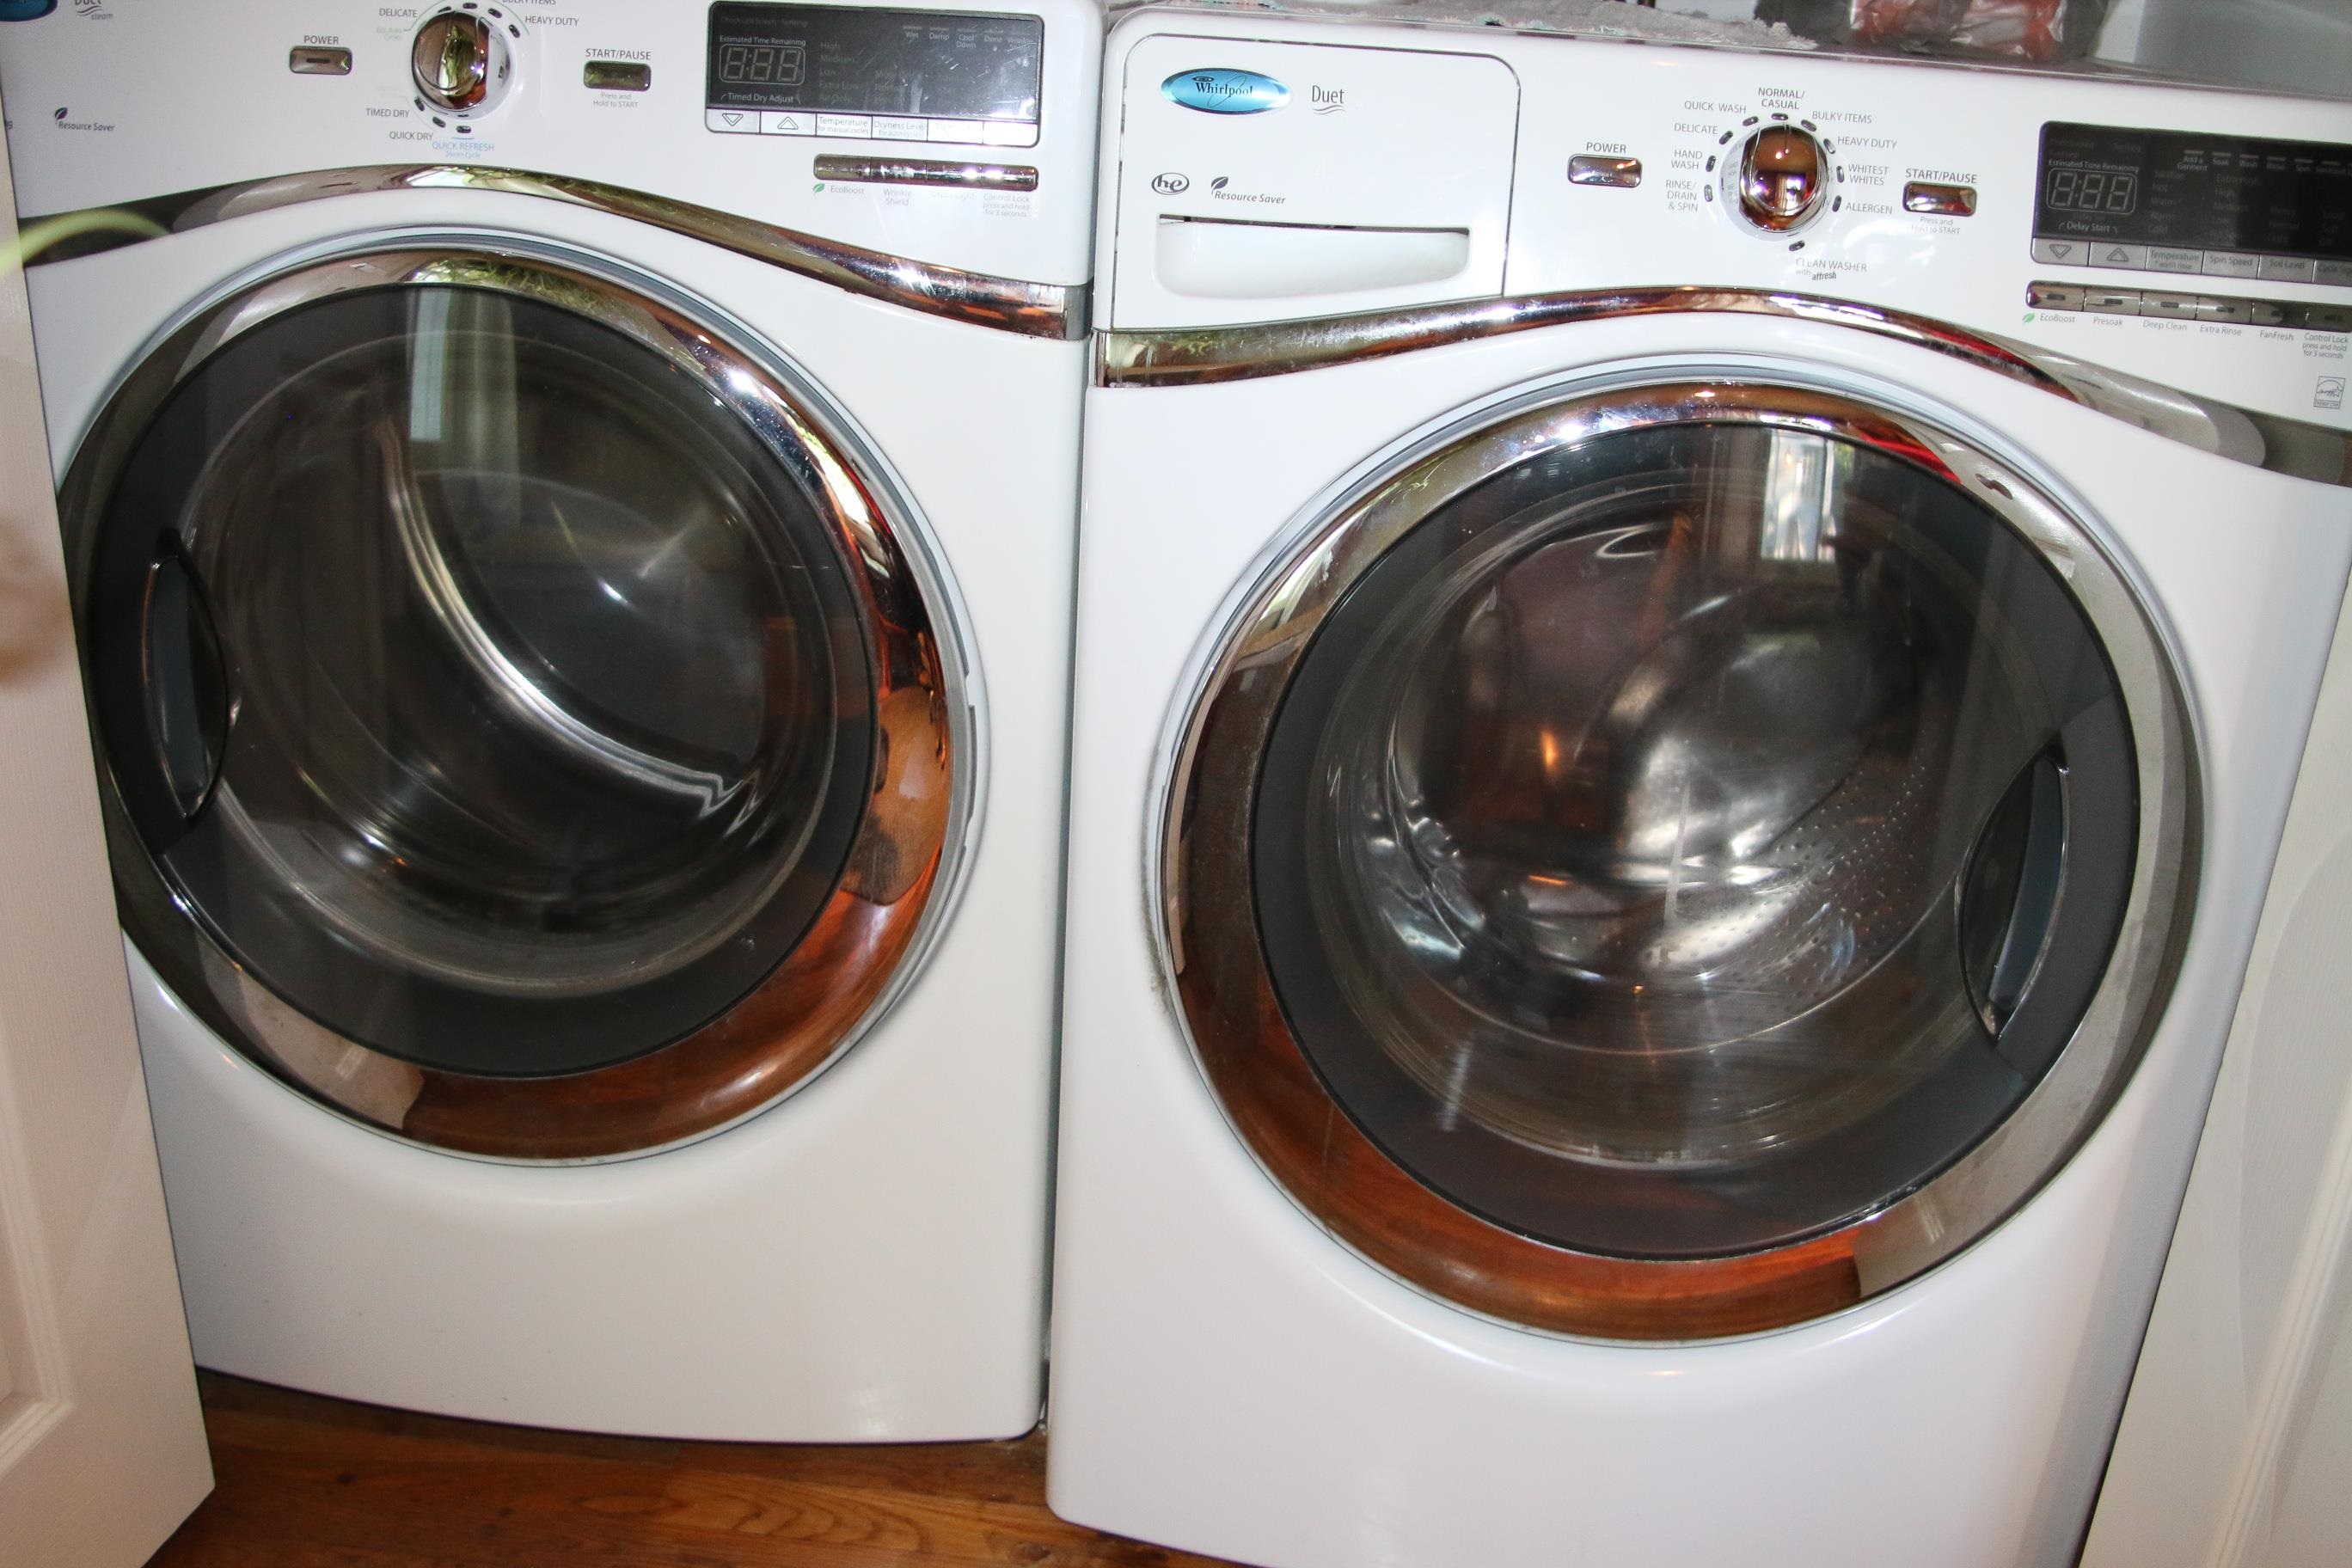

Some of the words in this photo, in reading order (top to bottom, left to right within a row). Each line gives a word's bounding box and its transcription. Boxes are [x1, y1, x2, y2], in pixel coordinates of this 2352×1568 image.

[91, 12, 113, 21] steam
[379, 8, 418, 18] DELICATE
[525, 15, 554, 25] HEAVY
[555, 17, 579, 27] DUTY
[303, 34, 340, 45] POWER
[720, 35, 752, 44] Estimated
[754, 36, 770, 45] Time
[771, 37, 806, 47] Remaining
[929, 33, 950, 41] Damp
[585, 48, 652, 60] START/PAUSE
[1195, 81, 1253, 98] Whirlpool
[1312, 85, 1344, 104] Duet
[1758, 87, 1805, 100] NORMAL/
[601, 91, 618, 100] Press
[728, 92, 752, 101] Timed
[754, 94, 768, 102] Dry
[769, 95, 794, 103] Adjust
[1684, 101, 1714, 111] QUICK
[1718, 103, 1747, 113] WASH
[1761, 98, 1800, 110] CASUAL
[366, 107, 392, 118] TIMED
[393, 109, 411, 118] DRY
[1811, 110, 1843, 120] BULKY
[1844, 113, 1872, 124] ITEMS
[58, 120, 92, 131] Resource
[94, 122, 115, 132] Saver
[819, 116, 868, 127] Temperature
[873, 120, 904, 130] Dryness
[1674, 123, 1718, 135] DELICATE
[389, 131, 414, 140] QUICK
[417, 132, 434, 141] DRY
[432, 141, 457, 150] QUICK
[459, 142, 495, 152] REFRESH
[1586, 141, 1626, 154] POWER
[1837, 136, 1870, 146] HEAVY
[1871, 138, 1897, 150] DUTY
[1674, 150, 1703, 160] HAND
[1671, 160, 1700, 170] WASH
[1848, 163, 1890, 175] WHITEST
[2049, 158, 2083, 168] Estimated
[2085, 160, 2103, 170] Time
[2103, 162, 2140, 174] Remaining
[2177, 162, 2208, 171] Garment
[1850, 175, 1885, 186] WHITES
[1906, 168, 1978, 184] START/PAUSE
[830, 185, 866, 195] EcoBoost
[1665, 180, 1697, 190] RINSE/
[882, 187, 913, 198] Wrinkle
[983, 193, 1010, 202] Control
[1215, 190, 1258, 203] Resource
[1259, 193, 1286, 205] Saver
[1667, 191, 1698, 200] DRAIN
[885, 197, 910, 207] Shield
[1678, 201, 1699, 211] SPIN
[1846, 202, 1894, 214] ALLERGEN
[1920, 216, 1939, 224] Press
[1939, 226, 1961, 235] START
[2067, 220, 2089, 232] Delay
[2091, 223, 2110, 232] Start
[2151, 249, 2199, 262] Temperature
[2210, 255, 2227, 265] Spin
[2229, 257, 2253, 266] Speed
[1795, 257, 1827, 269] CLEAN
[1828, 260, 1868, 273] WASHER
[1796, 267, 1812, 276] with
[1811, 271, 1838, 281] affresh
[2040, 313, 2076, 324] EcoBoost
[2093, 315, 2124, 327] Presoak
[2143, 319, 2165, 329] Deep
[2165, 322, 2188, 331] Clean
[2200, 324, 2220, 334] Extra
[2221, 326, 2243, 336] Rinse
[2259, 329, 2294, 341] FanFresh
[2304, 332, 2331, 343] Control
[2331, 335, 2349, 344] Lock
[2332, 344, 2348, 352] hold
